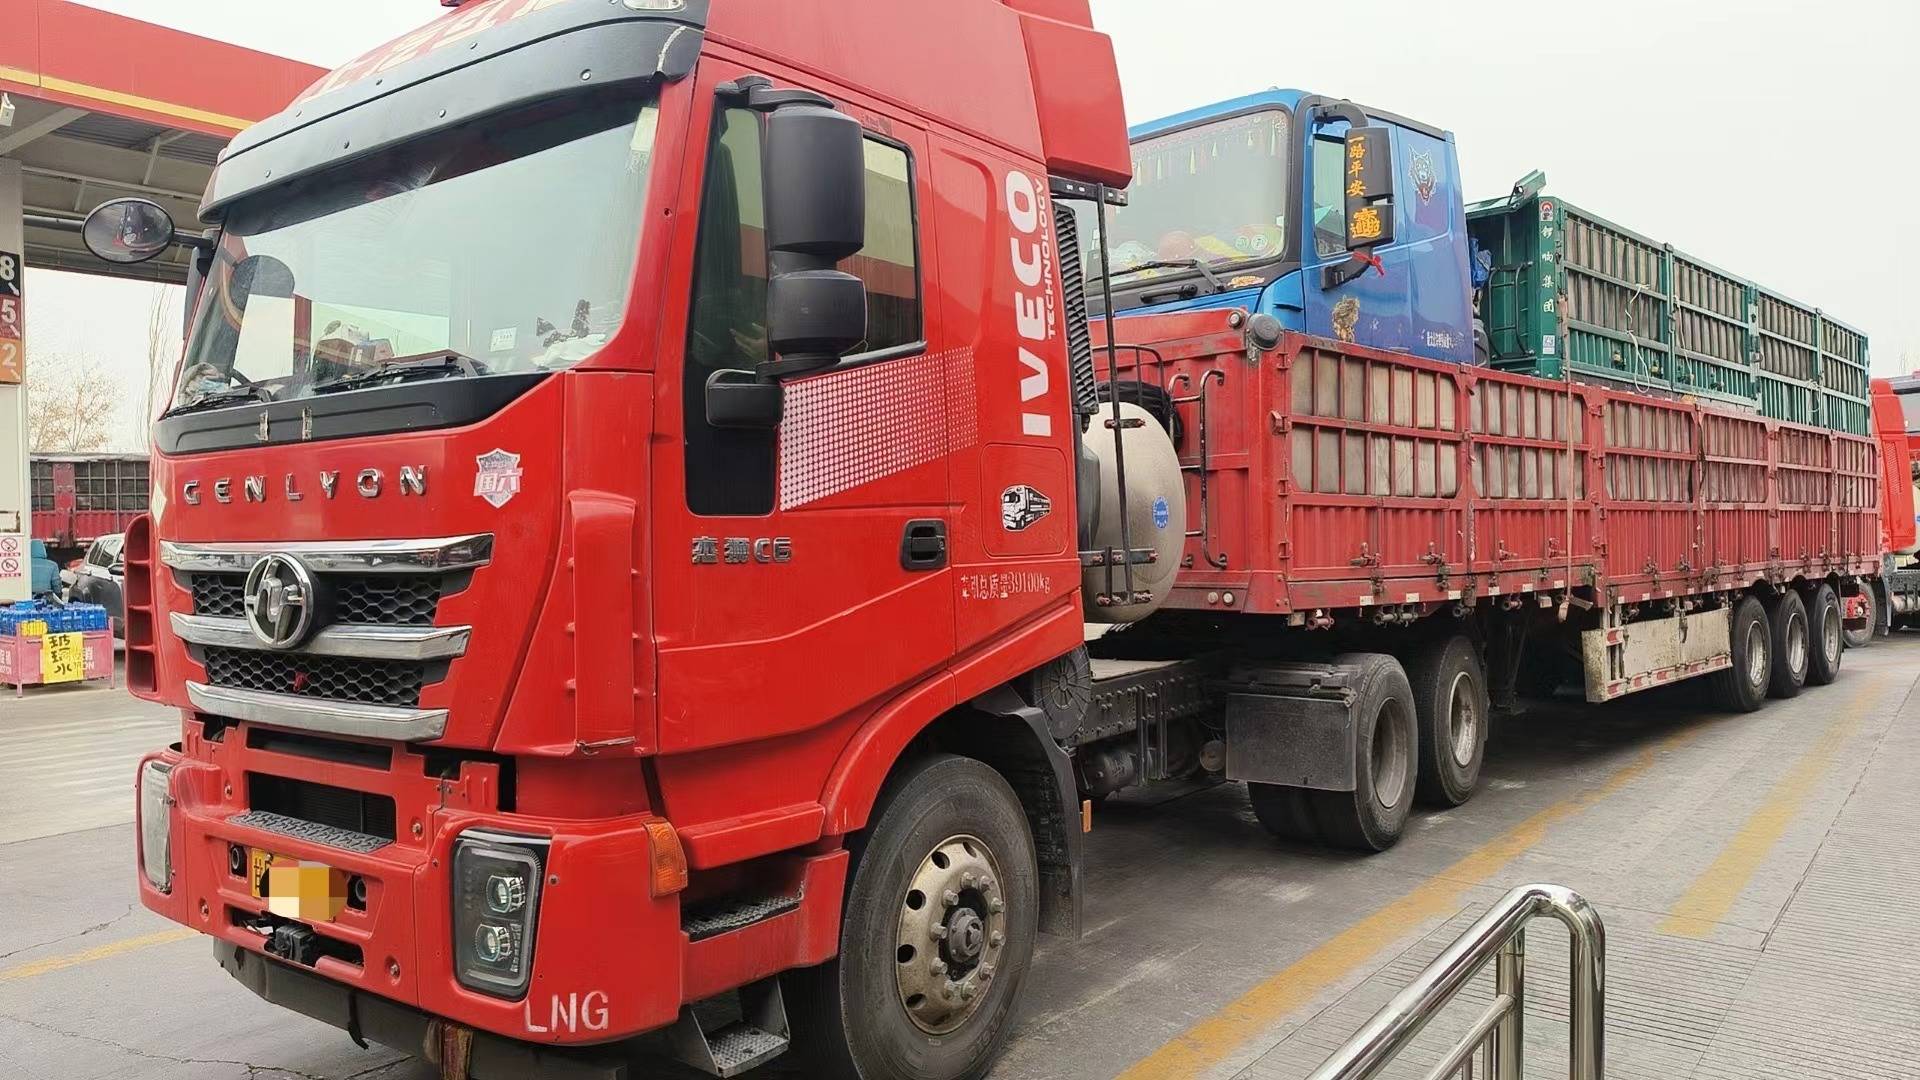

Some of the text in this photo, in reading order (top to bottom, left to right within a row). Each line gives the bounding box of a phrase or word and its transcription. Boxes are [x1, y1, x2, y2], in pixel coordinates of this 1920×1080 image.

[1346, 135, 1366, 197] 一路平安
[0, 255, 15, 281] 8
[1, 299, 17, 324] 5
[1006, 170, 1052, 437] IVECO
[2, 342, 17, 367] 2
[183, 465, 428, 505] GENLYON
[525, 990, 609, 1034] LNG
